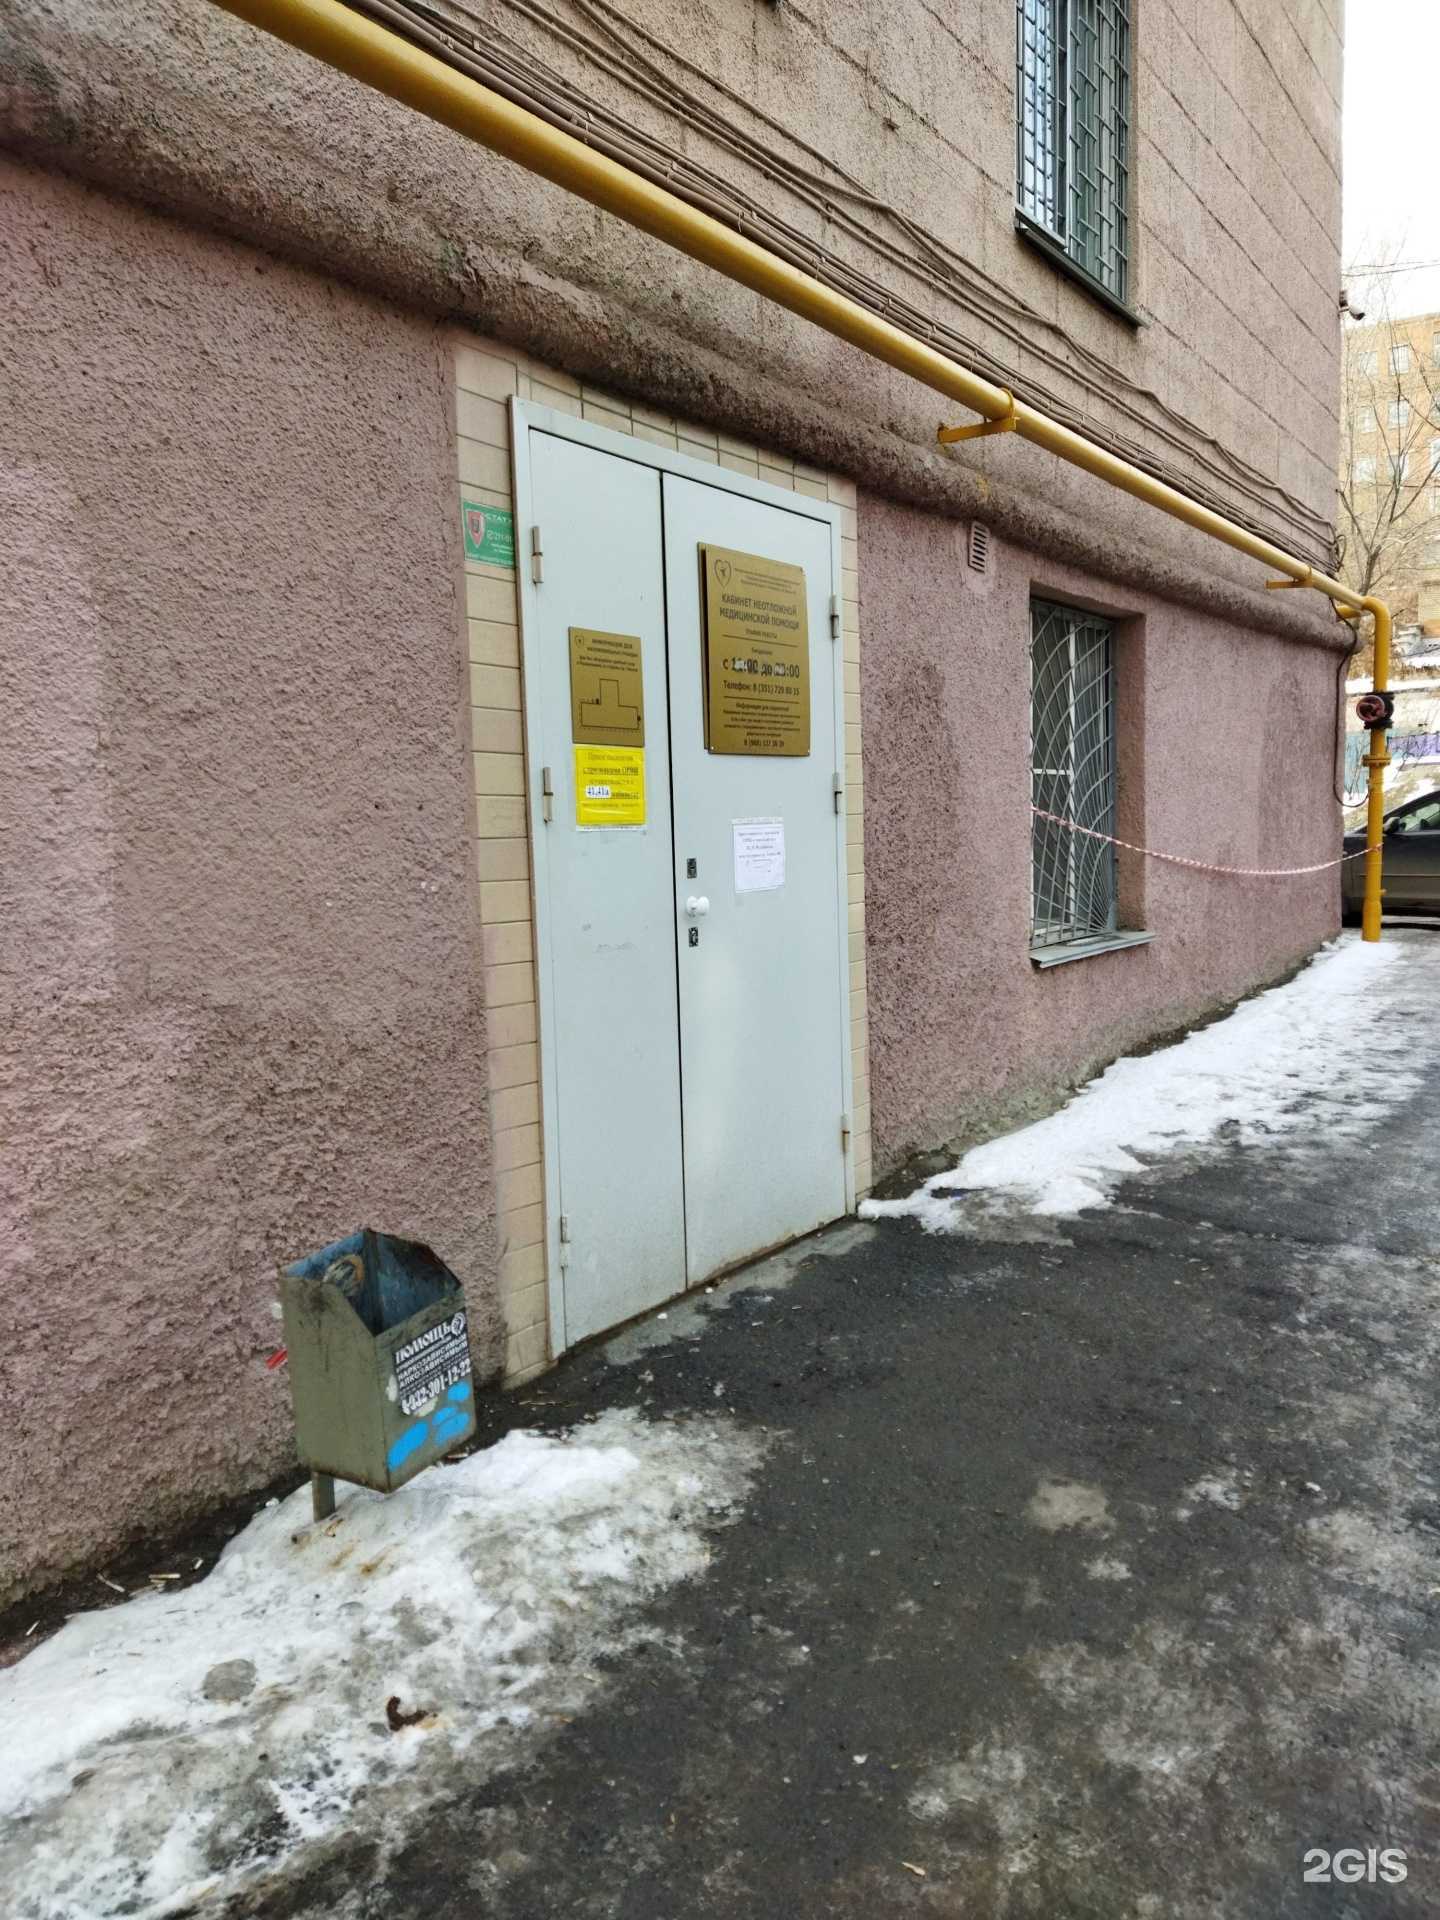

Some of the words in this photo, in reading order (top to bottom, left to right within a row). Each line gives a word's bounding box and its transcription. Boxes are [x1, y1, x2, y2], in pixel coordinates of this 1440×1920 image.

[720, 607, 770, 625] МЕДИЦИНСКОЙ
[722, 593, 752, 609] КАБИНЕТ
[754, 601, 797, 617] НЕОТЛОЖНОЙ
[396, 1321, 451, 1365] ПОМОЩЬ
[398, 1333, 467, 1381] НАРКОЗАВИСИМЫМ
[400, 1341, 468, 1388] АЛКОЗАВИСИМЫМ
